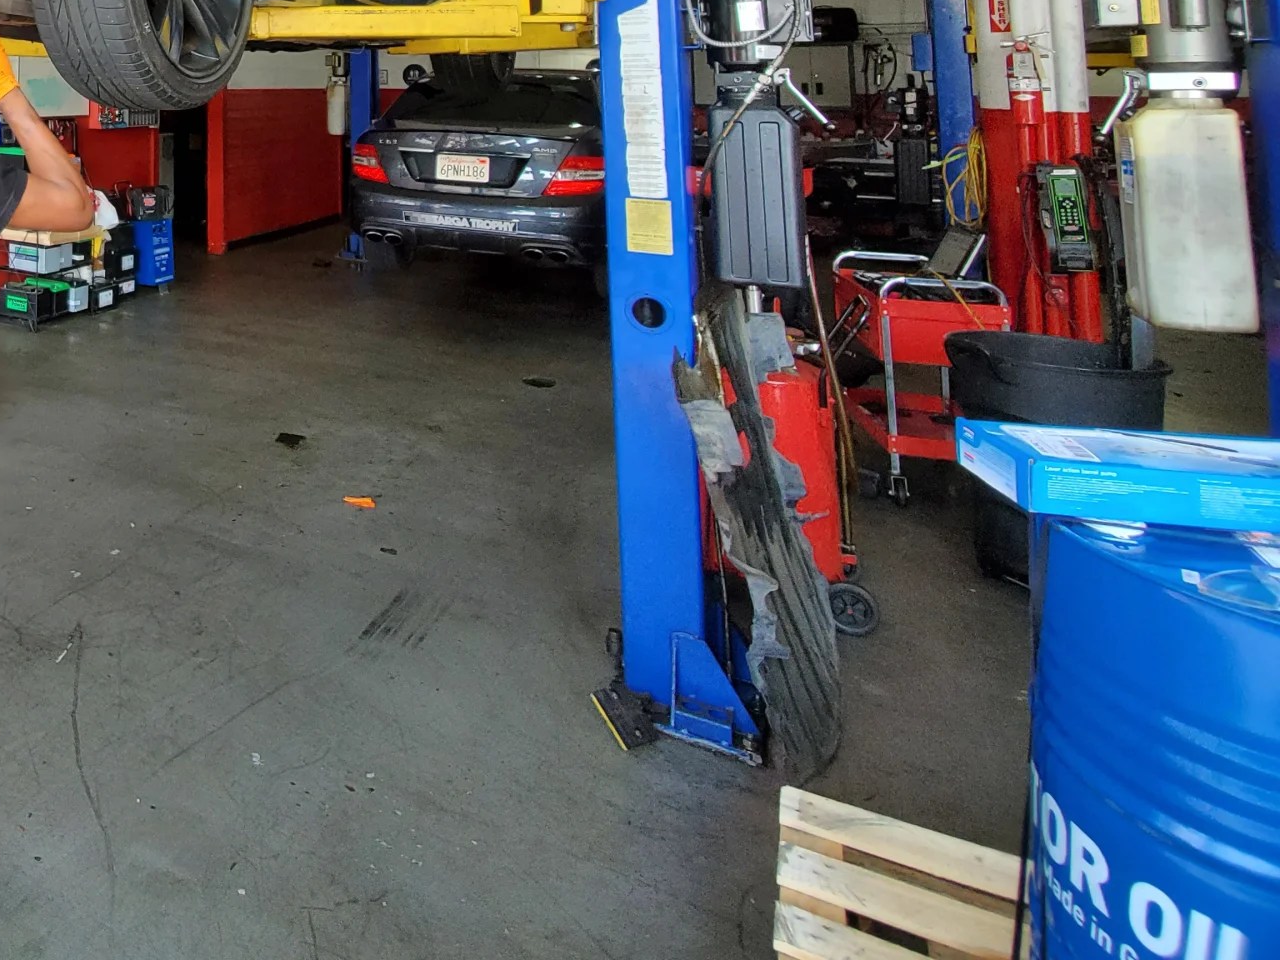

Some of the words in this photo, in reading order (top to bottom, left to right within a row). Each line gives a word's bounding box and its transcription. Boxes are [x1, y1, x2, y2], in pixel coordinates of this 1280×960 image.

[440, 163, 486, 178] 6PNH186
[470, 219, 516, 232] TROPHY
[1090, 915, 1114, 955] in
